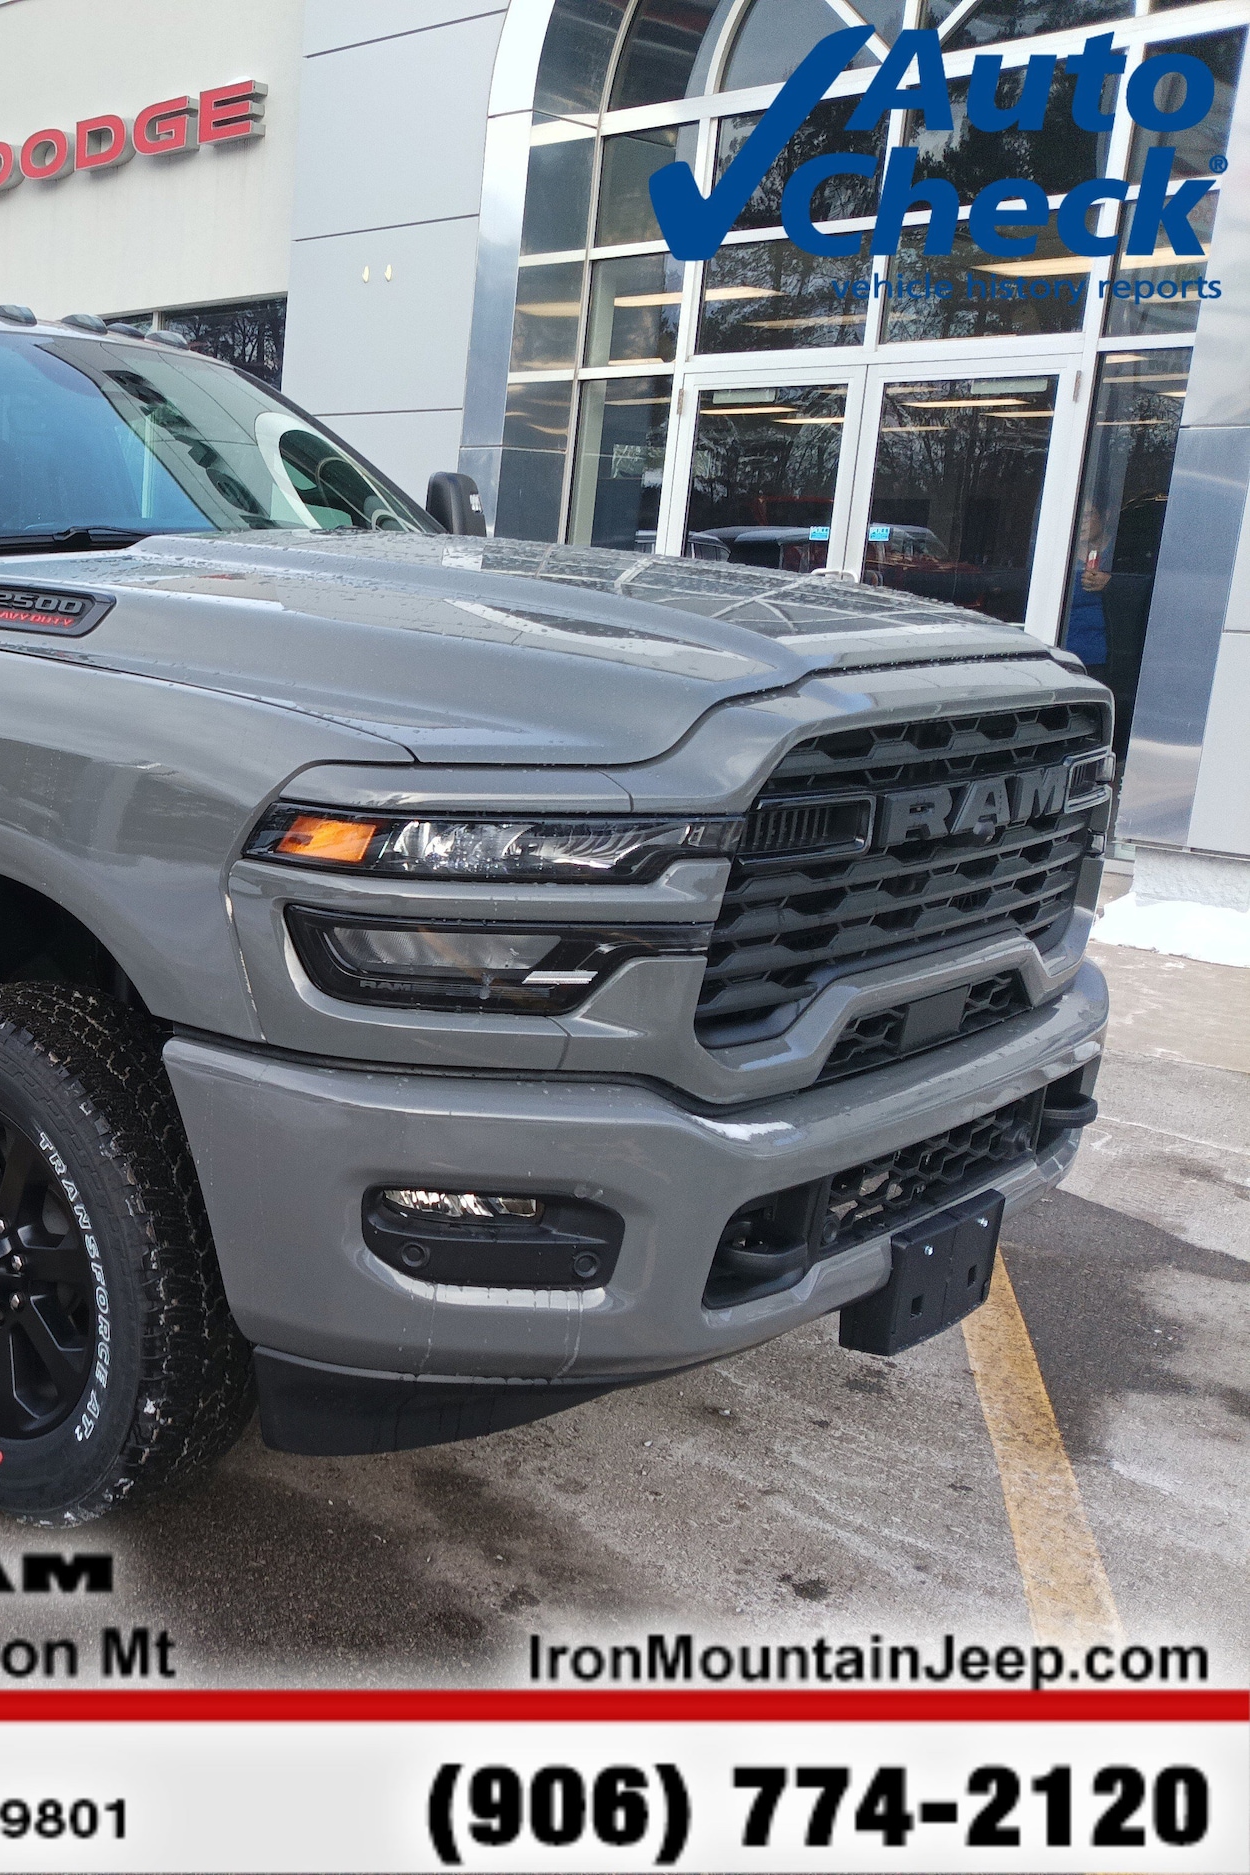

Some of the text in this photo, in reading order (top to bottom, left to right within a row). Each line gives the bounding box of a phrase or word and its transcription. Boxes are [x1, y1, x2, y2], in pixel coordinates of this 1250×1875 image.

[880, 763, 1068, 847] RAM
[359, 979, 411, 992] RAM
[39, 1132, 111, 1389] TRANSFORCE
